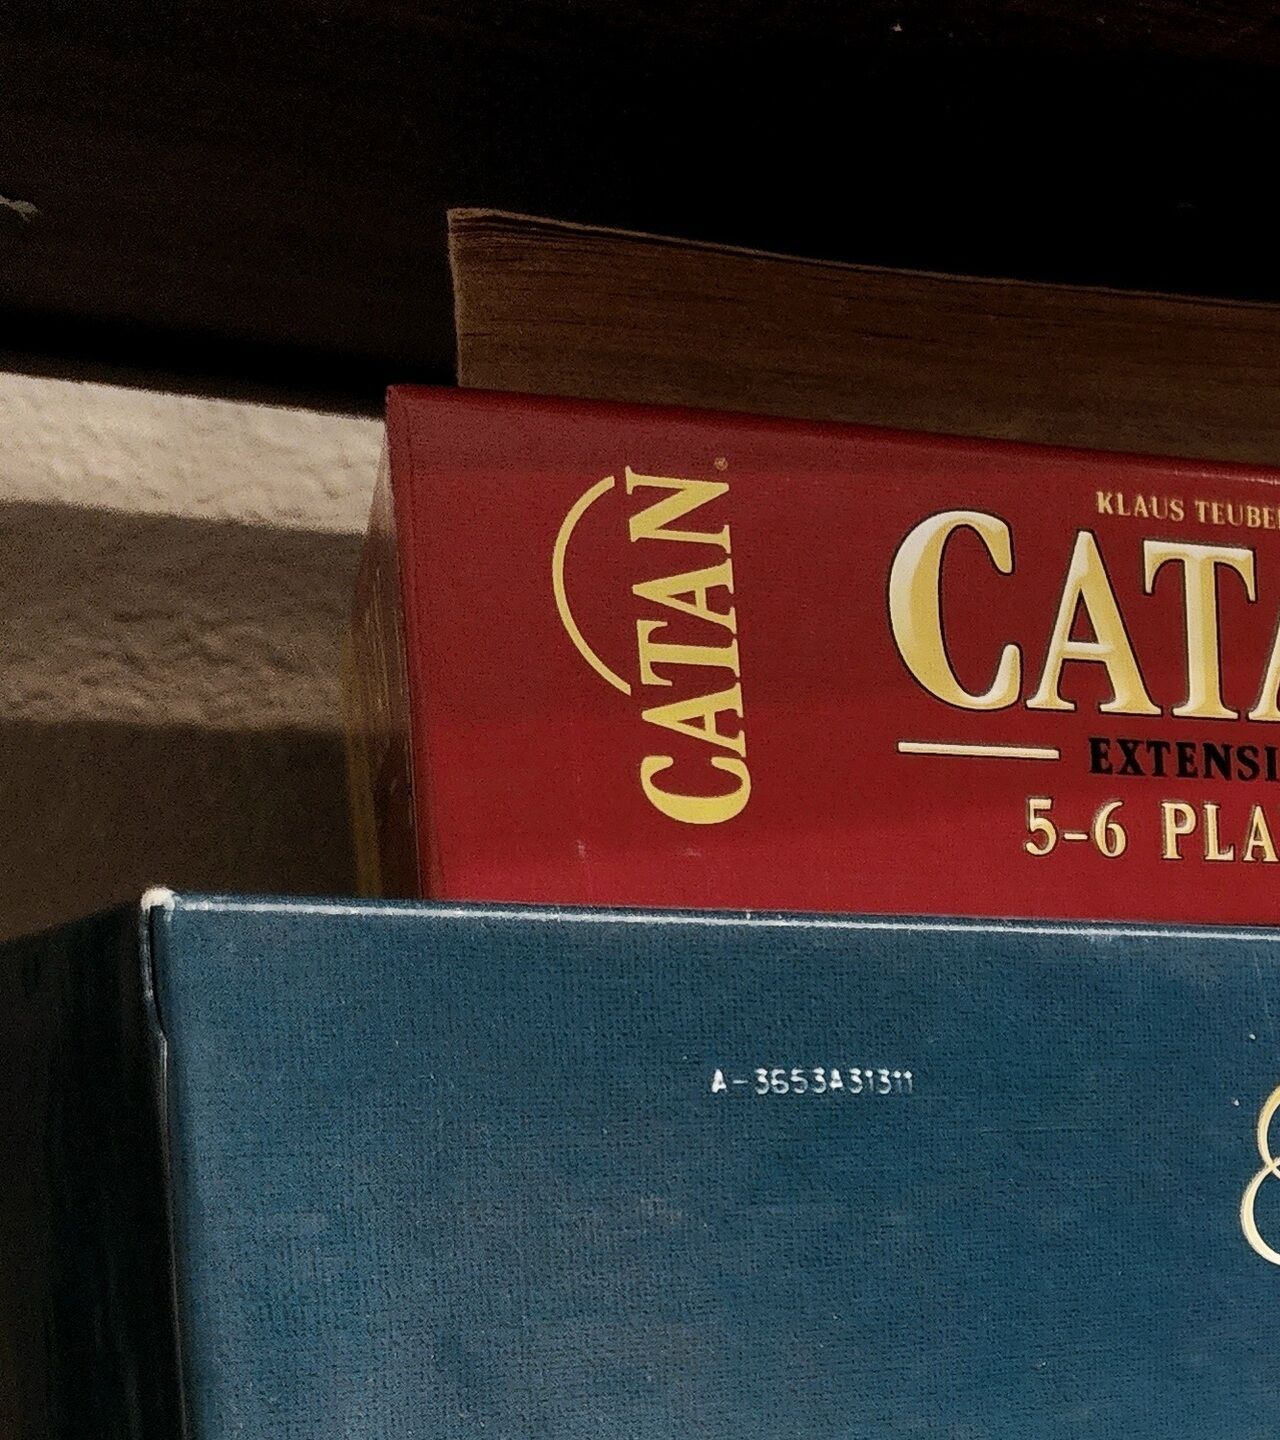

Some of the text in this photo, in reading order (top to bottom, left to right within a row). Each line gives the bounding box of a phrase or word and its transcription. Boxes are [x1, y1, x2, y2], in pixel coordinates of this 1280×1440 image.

[1097, 491, 1184, 522] KLAUS
[624, 466, 752, 824] CATAN
[1024, 796, 1128, 859] 5-6
